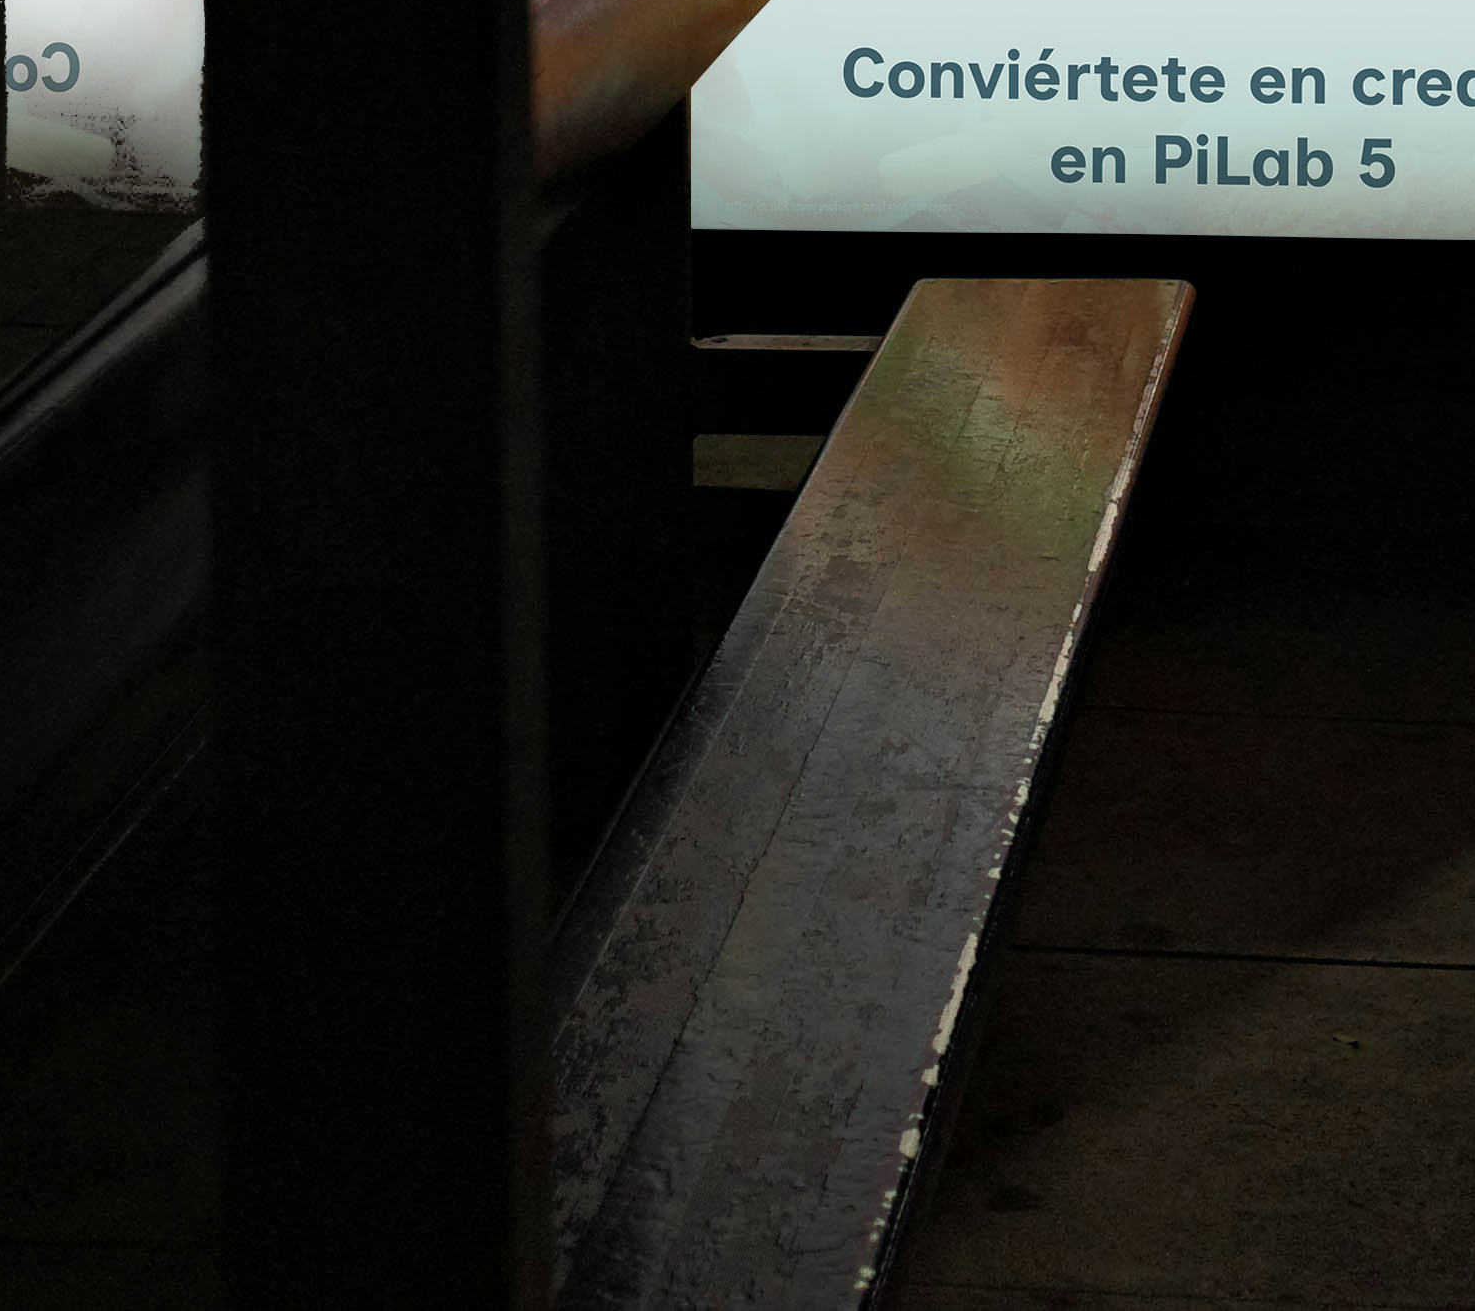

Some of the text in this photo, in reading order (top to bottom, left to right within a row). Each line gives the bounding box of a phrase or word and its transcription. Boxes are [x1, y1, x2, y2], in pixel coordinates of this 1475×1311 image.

[842, 47, 1226, 104] Conviértete
[1249, 66, 1326, 105] en
[1050, 133, 1396, 189] en PiLab 5
